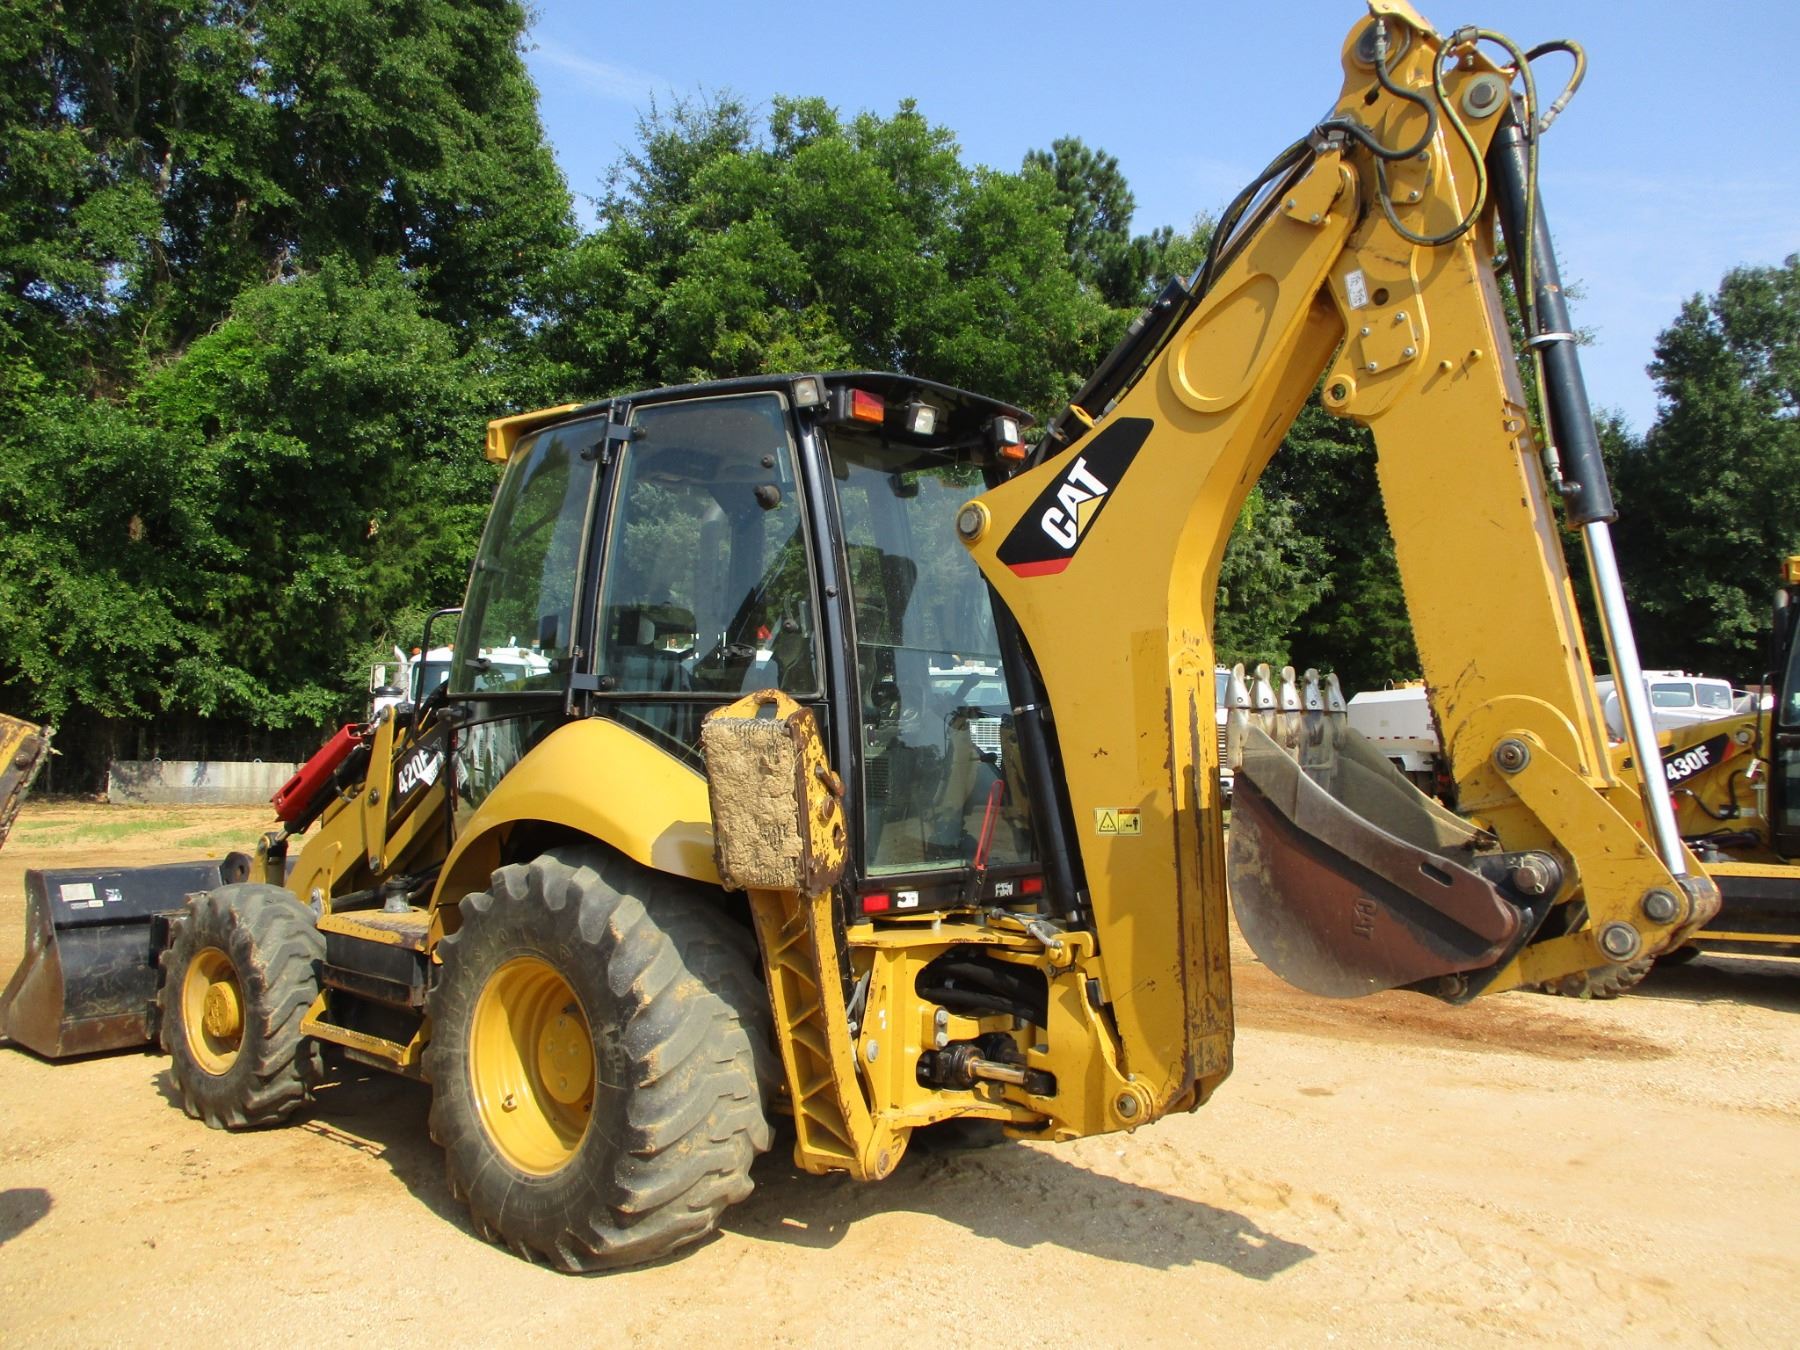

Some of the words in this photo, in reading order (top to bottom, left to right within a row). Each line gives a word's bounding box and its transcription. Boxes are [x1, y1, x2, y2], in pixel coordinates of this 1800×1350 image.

[1041, 456, 1109, 549] CAT
[1666, 745, 1710, 780] 430F
[1353, 898, 1377, 940] CAT
